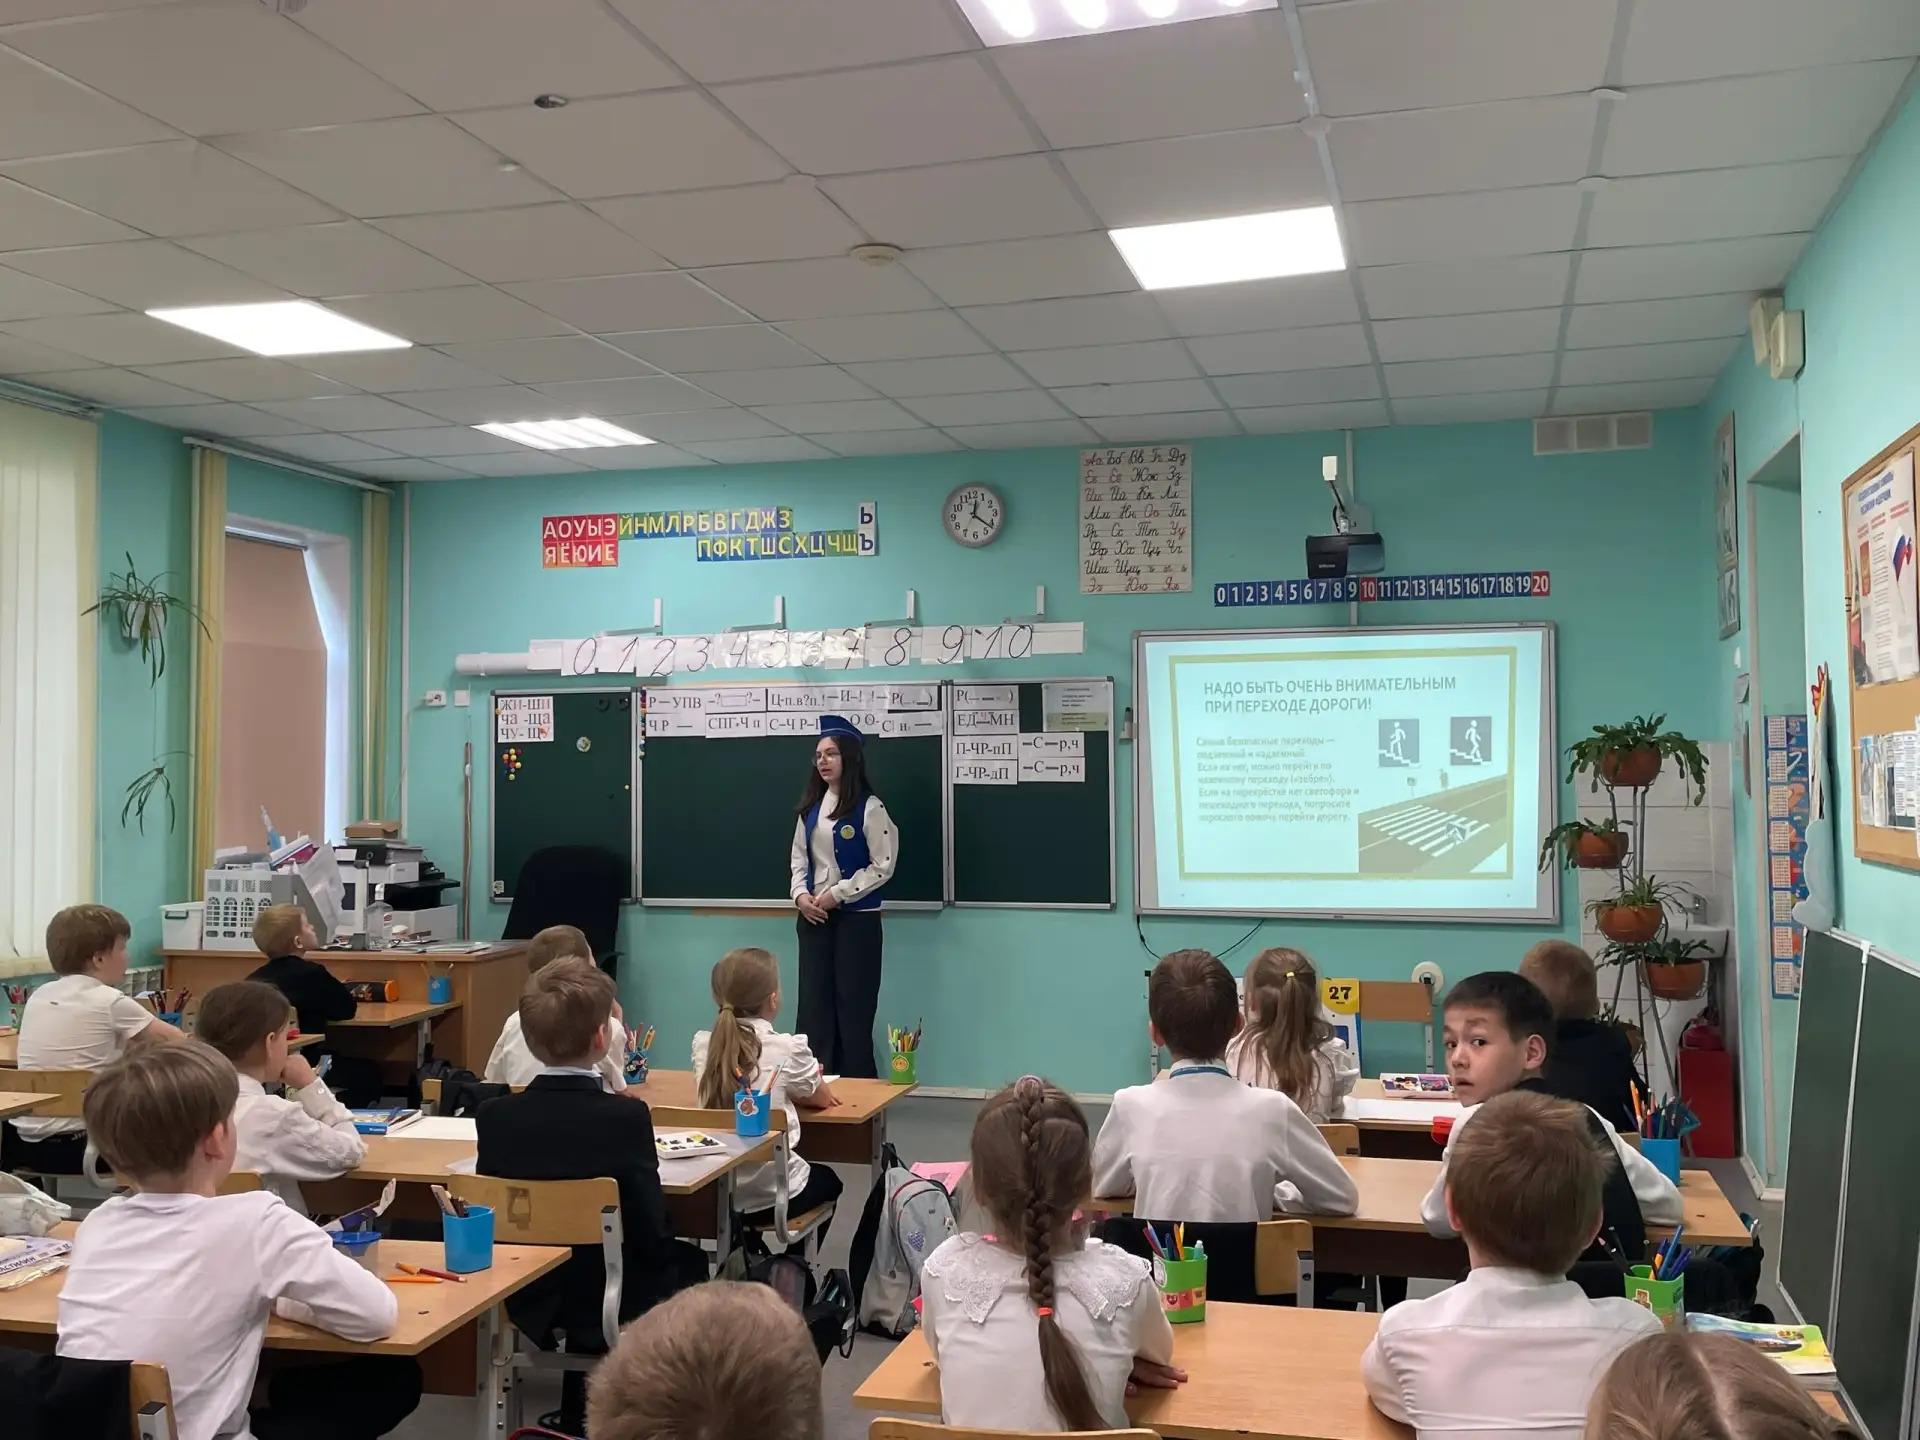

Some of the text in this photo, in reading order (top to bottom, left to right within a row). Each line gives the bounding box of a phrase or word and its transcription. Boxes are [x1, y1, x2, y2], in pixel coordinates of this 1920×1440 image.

[960, 495, 968, 503] 11
[968, 491, 978, 499] 12
[981, 493, 985, 501] 1
[953, 504, 962, 512] 10
[988, 500, 992, 508] 2
[951, 513, 956, 521] 9
[992, 509, 998, 517] 3
[955, 522, 960, 530] 8
[963, 529, 968, 537] 7
[983, 527, 988, 535] 5
[1217, 575, 1548, 603] 0 1 2 3 4 5 6 7 8 9 10 11 12 13 14 15 16 17 18 19 20
[574, 638, 596, 675] 0
[618, 637, 638, 672] 1
[651, 639, 676, 676] 2
[687, 638, 711, 672] 3
[730, 632, 747, 667] 4
[885, 628, 911, 666] 8
[937, 625, 964, 664] 9
[984, 625, 1032, 659] 10
[1204, 677, 1456, 697] НАДО БЫТЬ ОЧЕНЬ ВНИМАТЕЛЬНЫМ
[1205, 697, 1372, 715] ПРИ ПЕРЕХОДЕ ДОРОГИ!
[1281, 737, 1324, 746] переходы
[1305, 787, 1351, 797] светофора
[1304, 800, 1351, 809] попросите
[1279, 813, 1315, 823] перейти
[1328, 986, 1352, 1000] 27
